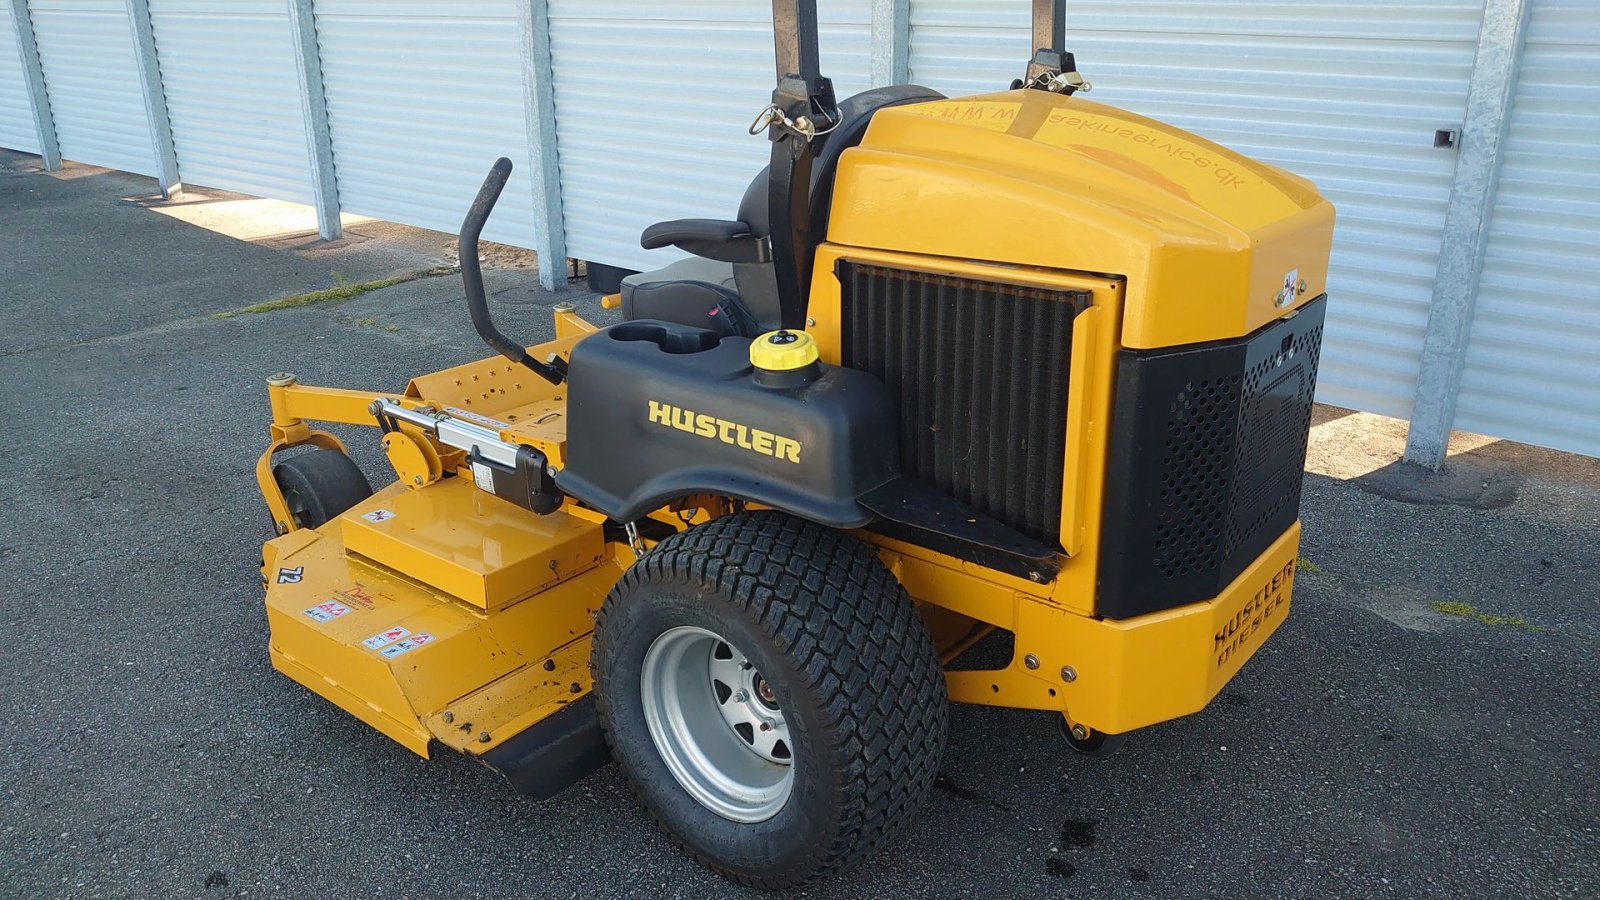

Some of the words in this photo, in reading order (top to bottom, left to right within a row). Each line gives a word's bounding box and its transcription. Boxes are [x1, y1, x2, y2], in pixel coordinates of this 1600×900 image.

[648, 400, 801, 464] HUSTLER
[277, 566, 304, 584] 72
[1214, 559, 1295, 654] HUSTLER
[1217, 593, 1285, 669] DIESEL
